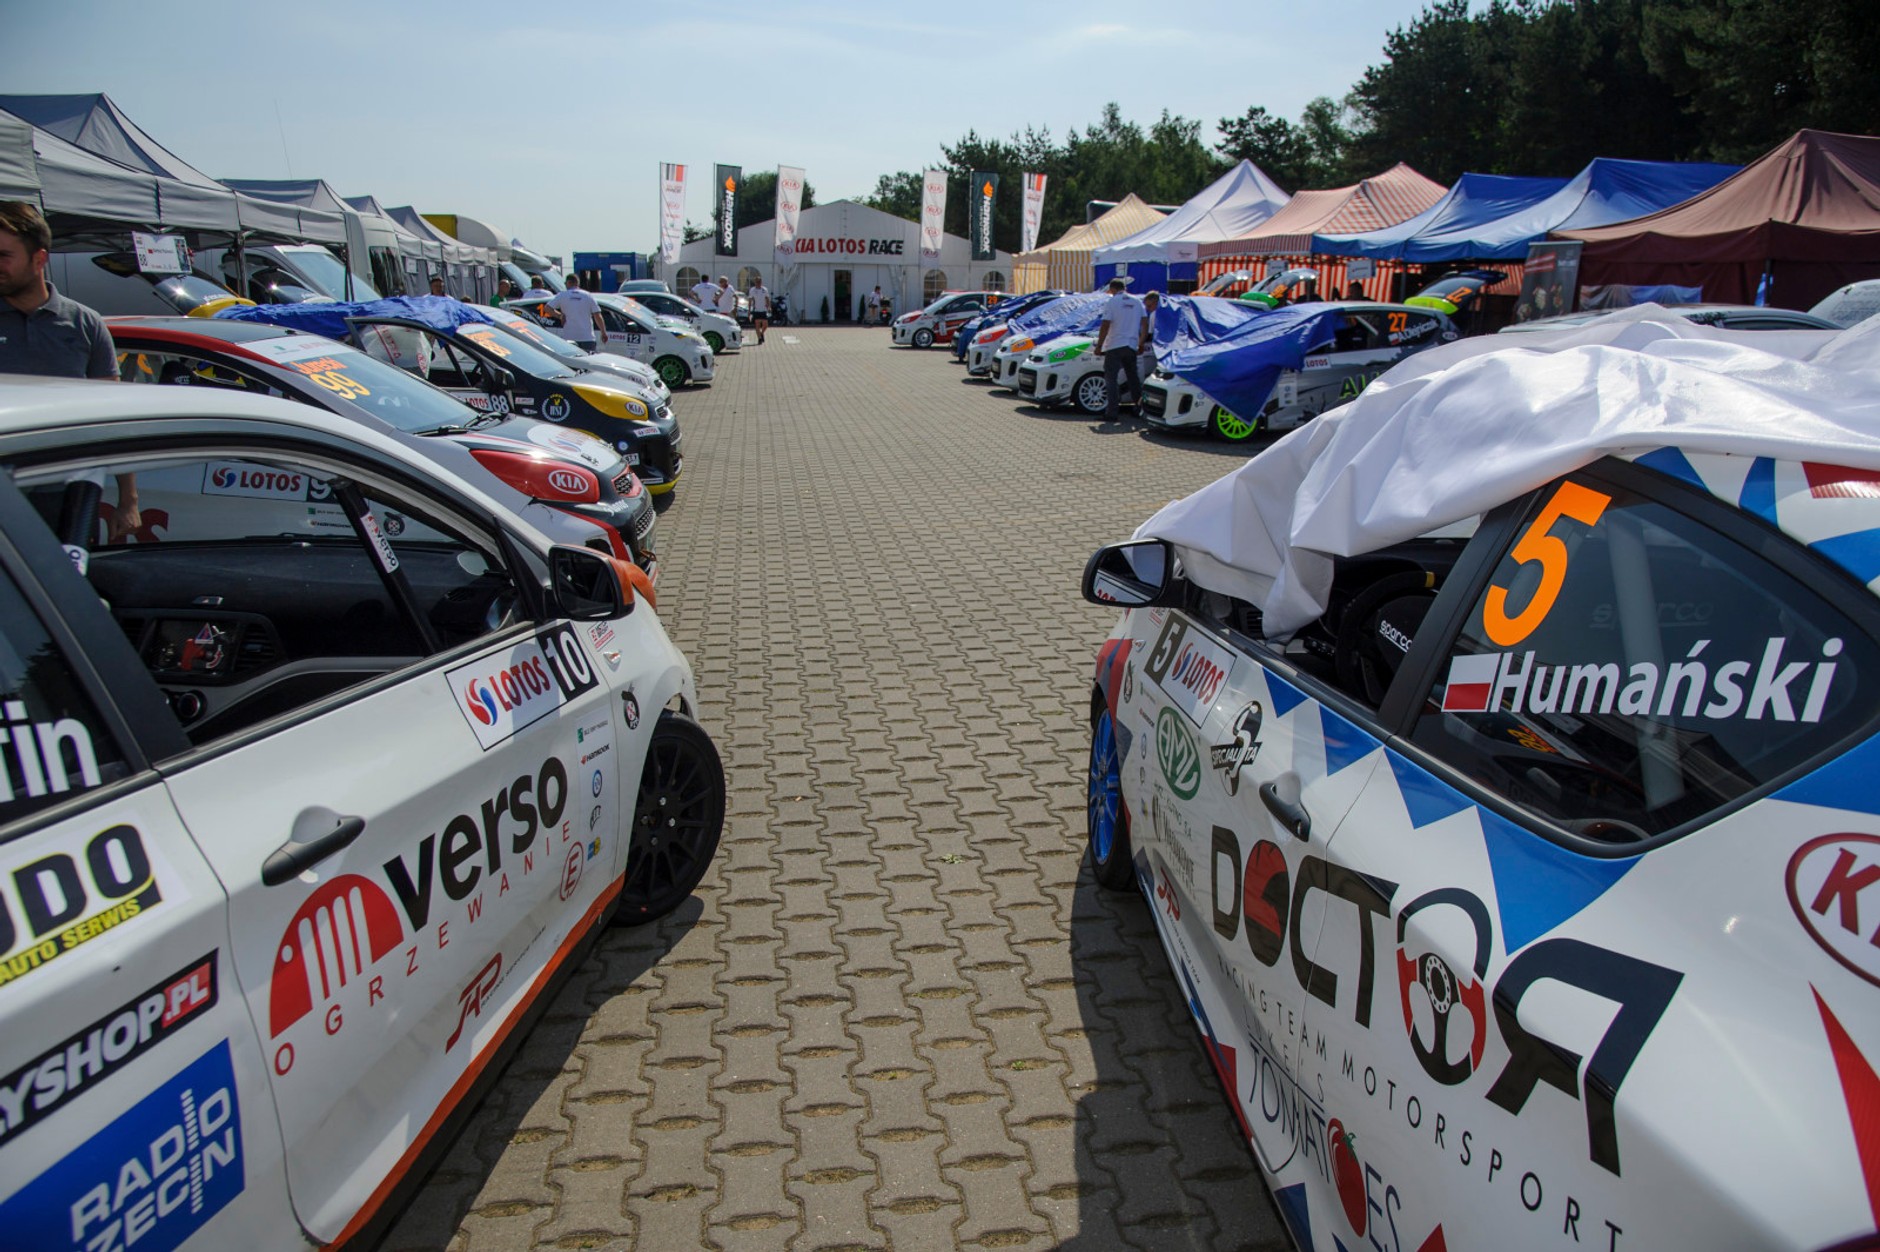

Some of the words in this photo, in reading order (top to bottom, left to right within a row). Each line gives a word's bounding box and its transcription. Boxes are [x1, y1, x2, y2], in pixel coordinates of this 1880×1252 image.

[818, 238, 866, 254] LOTOS
[868, 239, 904, 255] RACE
[627, 334, 640, 344] 12
[1306, 359, 1329, 367] LOTOS
[1387, 313, 1408, 332] 27
[310, 371, 371, 400] 99
[491, 394, 510, 414] 88
[627, 403, 645, 415] KIA
[240, 471, 301, 492] LOTOS
[555, 473, 583, 491] KIA
[1483, 481, 1612, 646] 5
[1591, 602, 1713, 630] srco
[489, 656, 551, 712] LOTOS
[545, 631, 592, 694] 10
[1152, 621, 1180, 673] 5
[1182, 651, 1224, 705] LOTOS
[1490, 637, 1844, 723] Humański
[383, 756, 568, 933] verso
[0, 824, 153, 952] DO
[0, 939, 59, 986] AUTO
[60, 898, 142, 951] SERWIS
[274, 819, 570, 1076] OGRZEWANIE
[0, 973, 209, 1135] YSHOP.PL
[71, 1087, 231, 1243] RADIO
[1276, 1001, 1328, 1062] TEAM
[1341, 1050, 1623, 1252] MOTORSPORT
[77, 1126, 236, 1252] ZECIN
